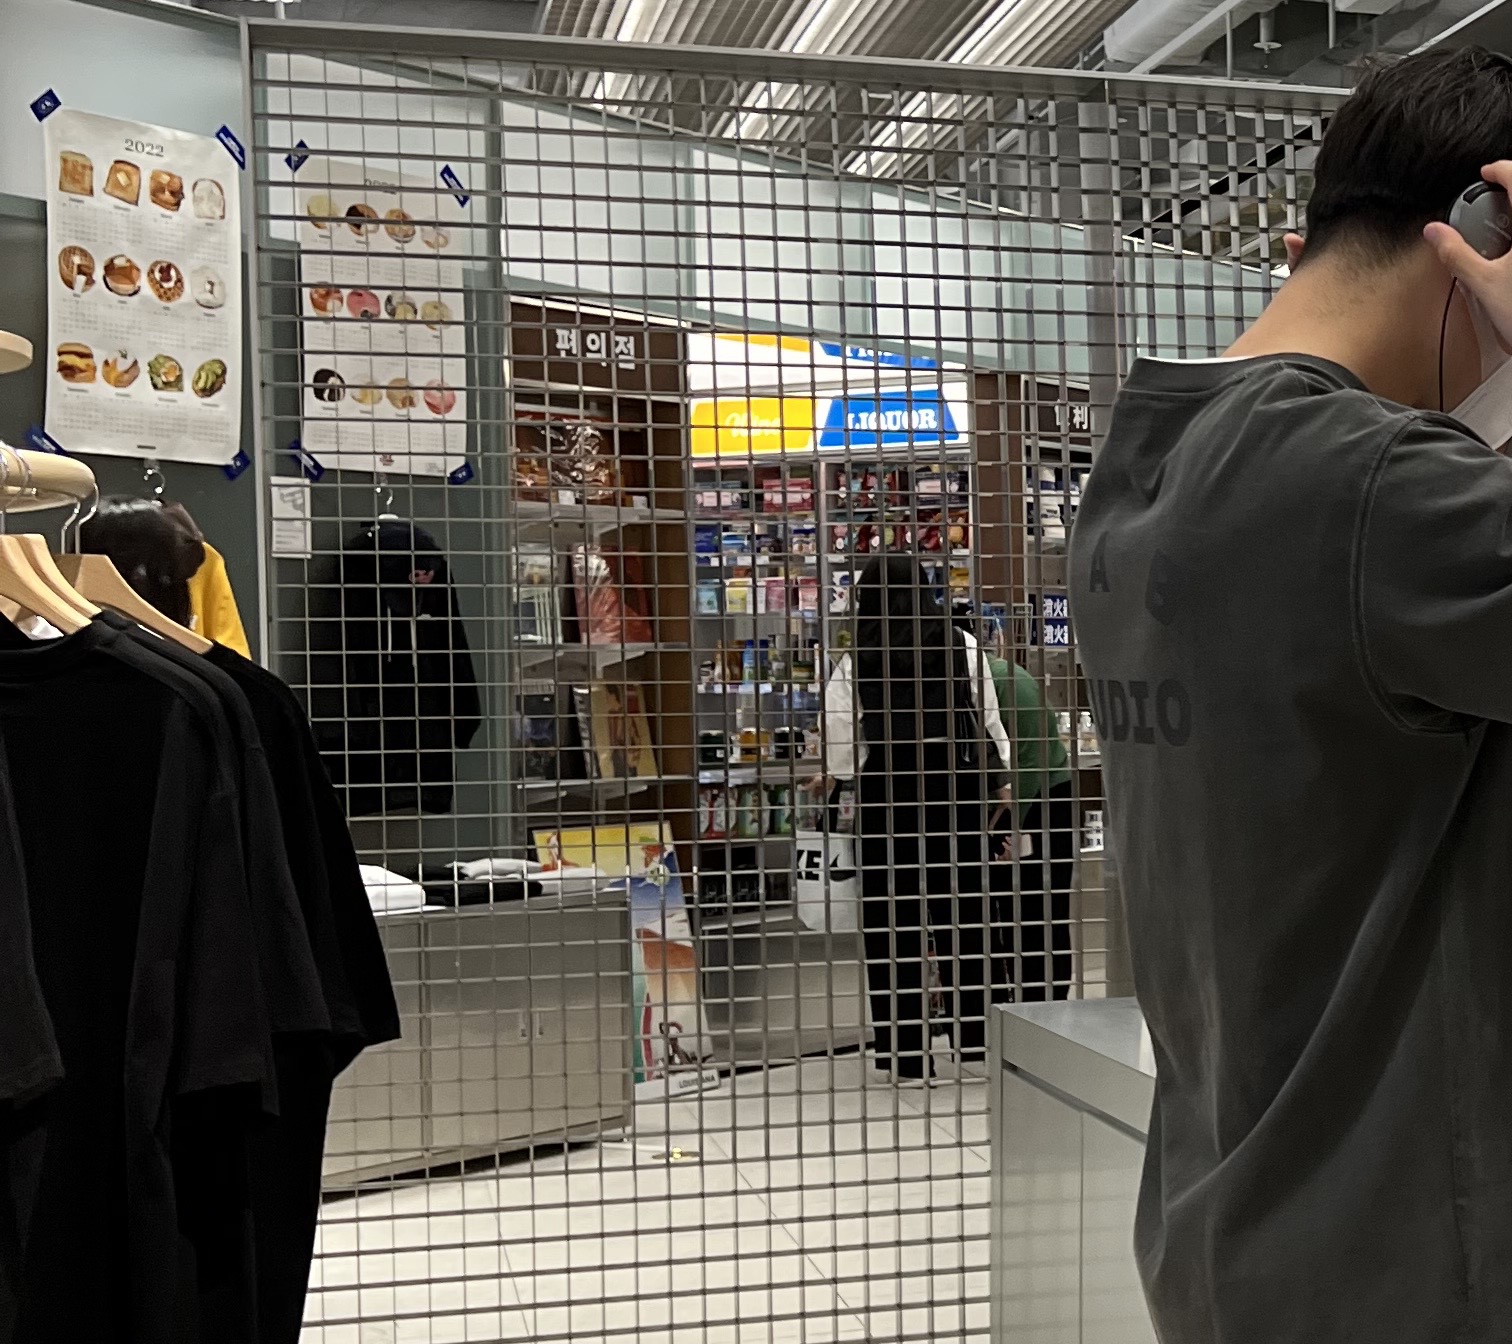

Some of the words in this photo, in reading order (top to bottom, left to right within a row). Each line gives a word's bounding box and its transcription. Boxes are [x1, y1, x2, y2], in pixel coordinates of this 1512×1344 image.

[124, 138, 165, 157] 2022
[555, 328, 636, 370] 편의점
[847, 408, 937, 431] LIQUOR
